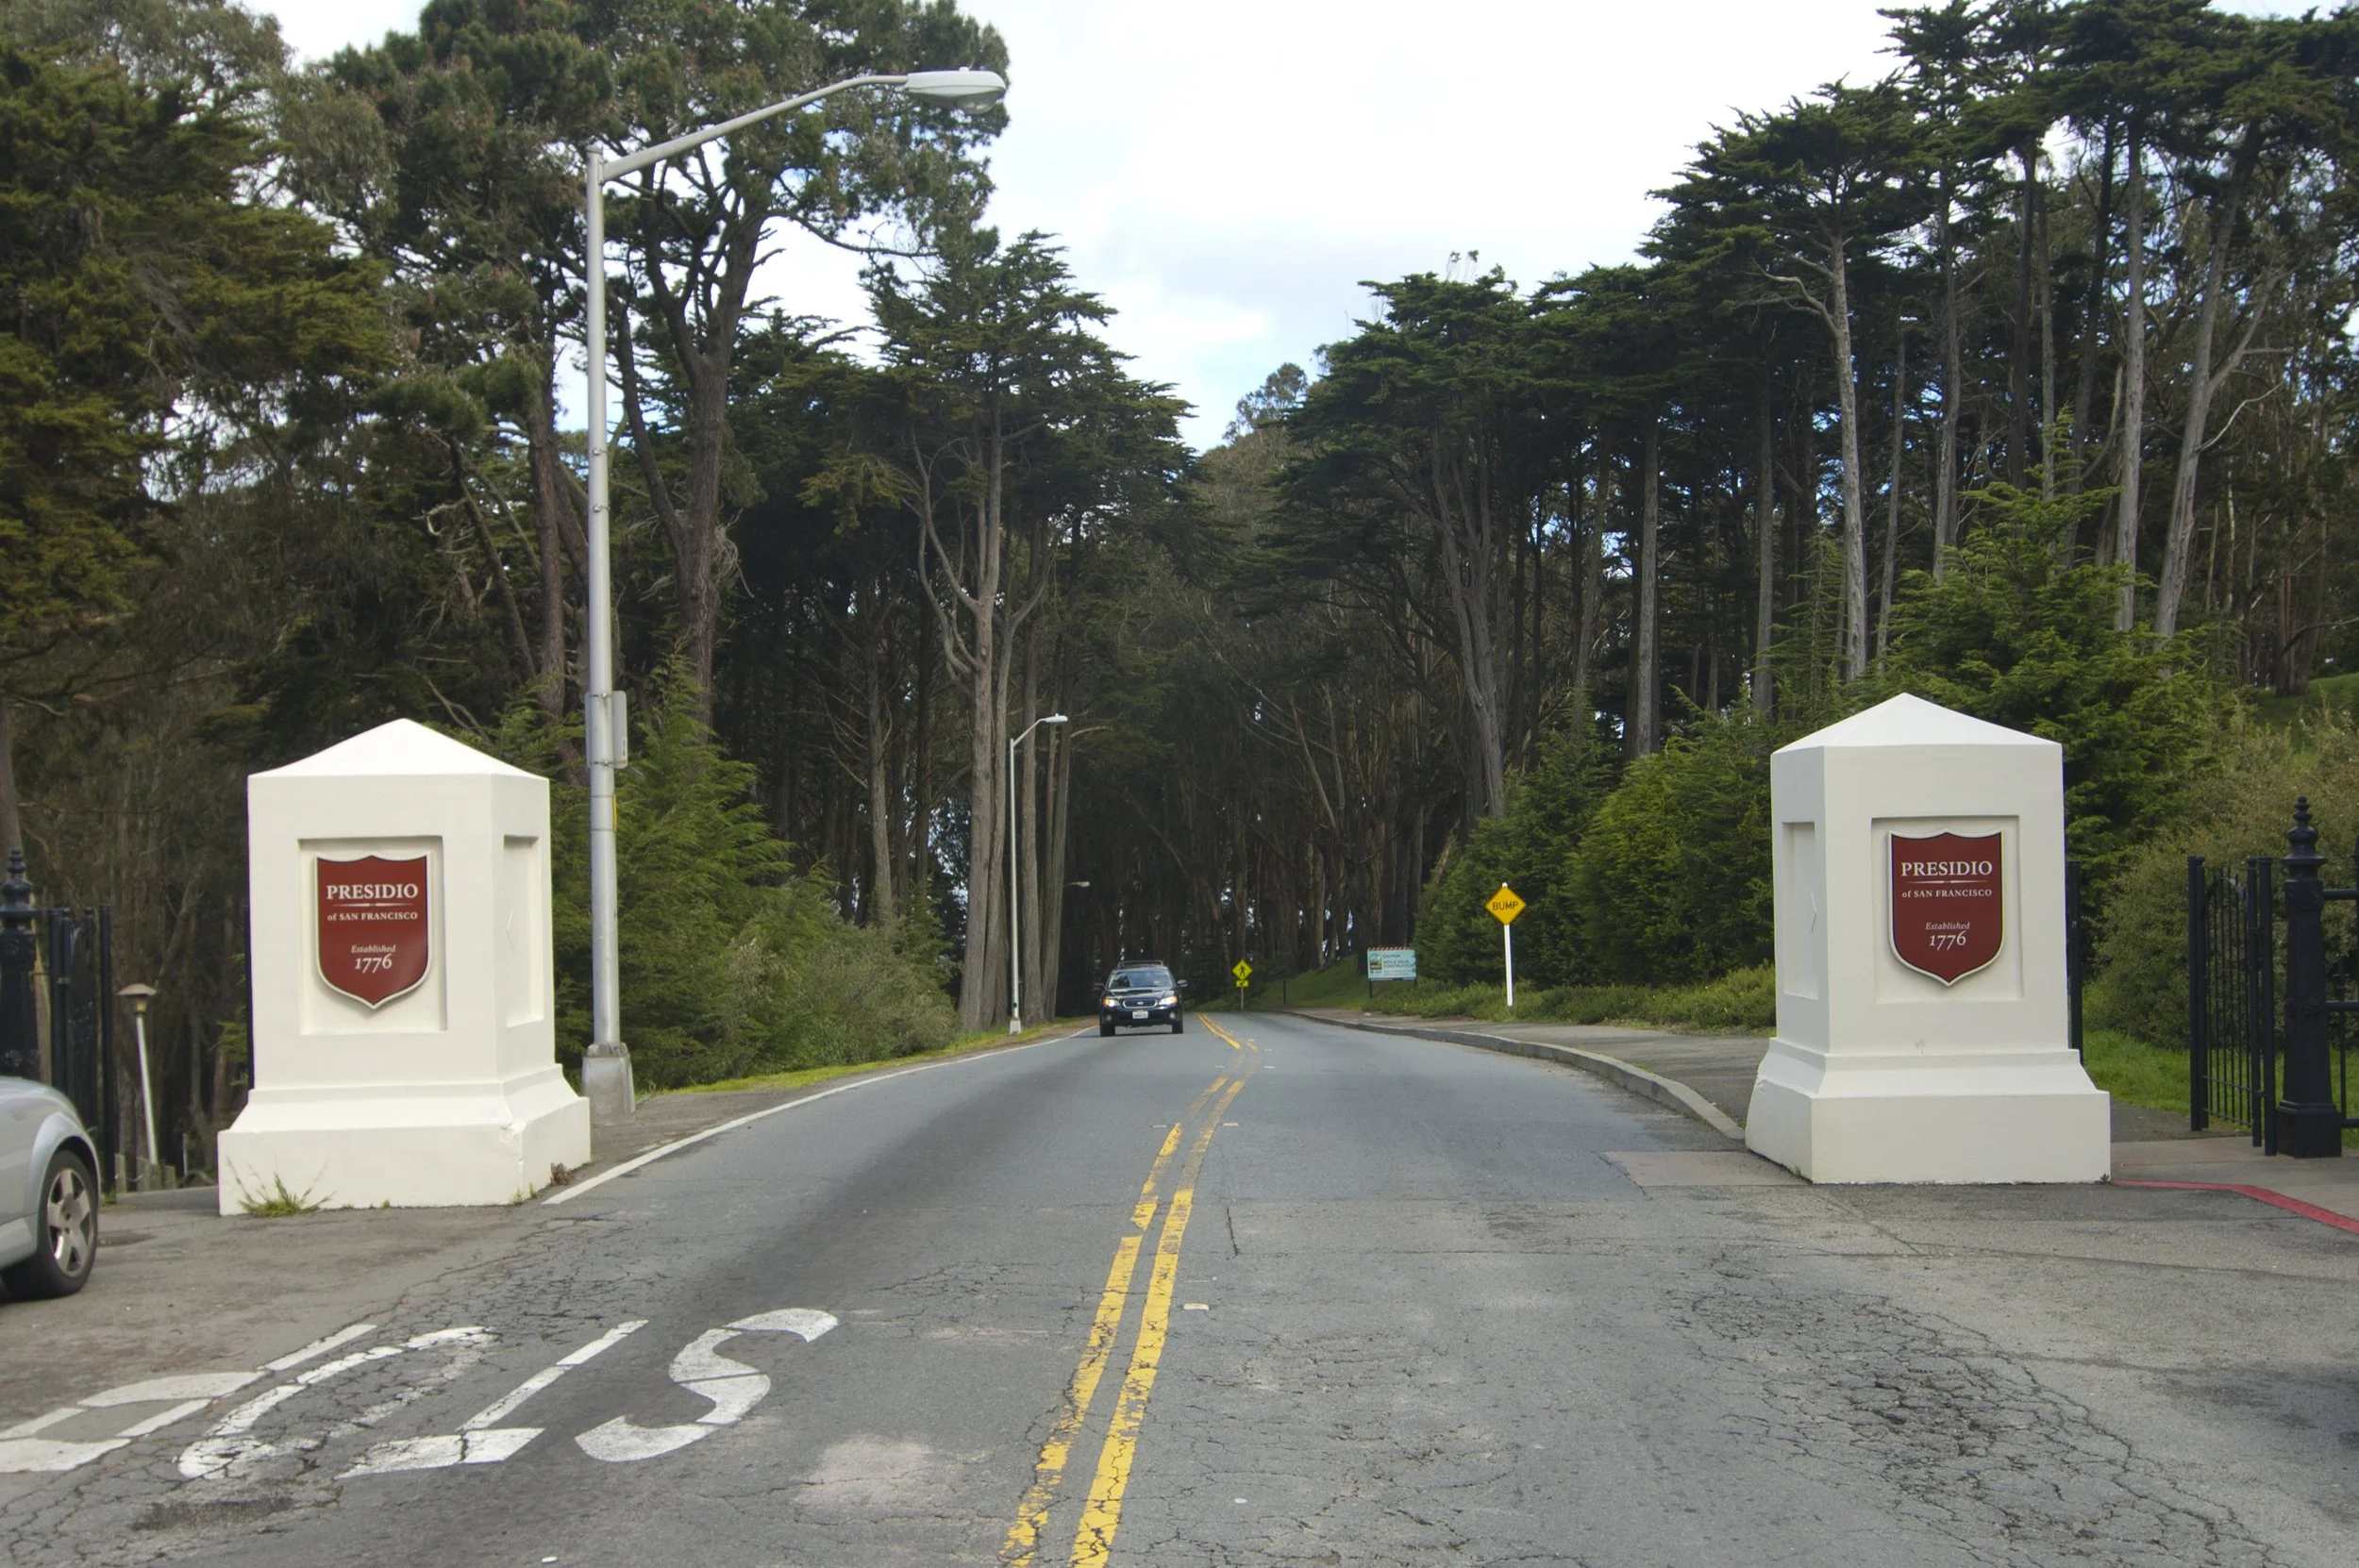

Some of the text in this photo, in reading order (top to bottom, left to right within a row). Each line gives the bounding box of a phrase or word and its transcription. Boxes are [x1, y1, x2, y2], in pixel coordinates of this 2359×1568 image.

[1900, 860, 1993, 876] PRESIDIO
[326, 883, 419, 899] PRESIDIO
[1901, 889, 1993, 898] of SAN FRANCISCO
[1492, 901, 1519, 910] BUMP
[327, 911, 418, 921] of SAN FRANCISCO
[1925, 922, 1970, 930] Established
[1929, 930, 1966, 951] 1776
[350, 944, 396, 954] Established
[354, 953, 393, 974] 1776
